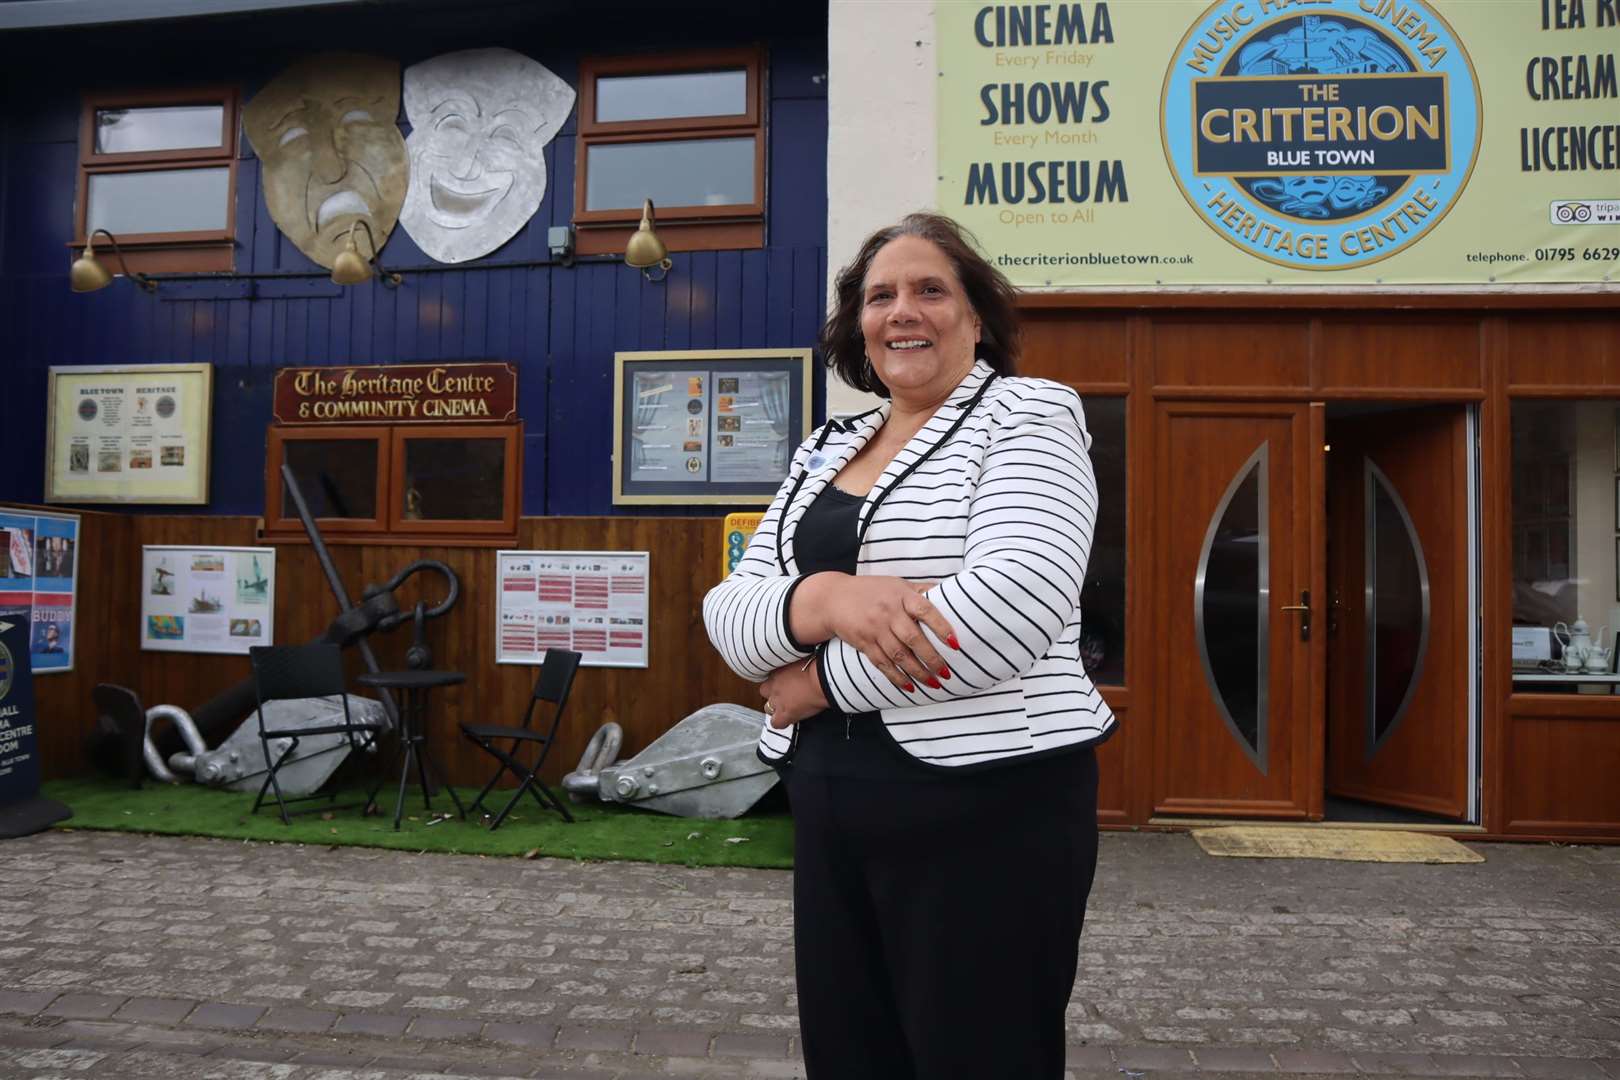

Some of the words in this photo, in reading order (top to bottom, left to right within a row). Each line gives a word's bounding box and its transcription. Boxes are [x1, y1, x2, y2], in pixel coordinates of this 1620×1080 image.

[974, 3, 1114, 47] CINEMA
[1186, 4, 1254, 74] MUSIC
[1359, 0, 1448, 68] CINEMA
[995, 52, 1039, 68] Every
[1046, 50, 1094, 67] Friday
[1526, 54, 1618, 100] CREAM
[980, 80, 1110, 126] SHOWS
[1298, 84, 1340, 101] THE
[1200, 105, 1440, 143] CRITERION
[994, 132, 1039, 149] Every
[1045, 130, 1098, 146] Month
[1267, 151, 1310, 166] BLUE
[1315, 149, 1375, 165] TOWN
[964, 160, 1129, 205] MUSEUM
[999, 209, 1045, 228] Open
[1050, 211, 1068, 224] to
[1072, 209, 1094, 224] All
[1535, 247, 1575, 261] 01795
[294, 371, 337, 396] The
[340, 369, 424, 399] Heritage
[426, 368, 494, 394] Centre
[299, 402, 310, 418] &
[313, 400, 418, 418] COMMUNITY
[423, 398, 490, 417] CINEMA
